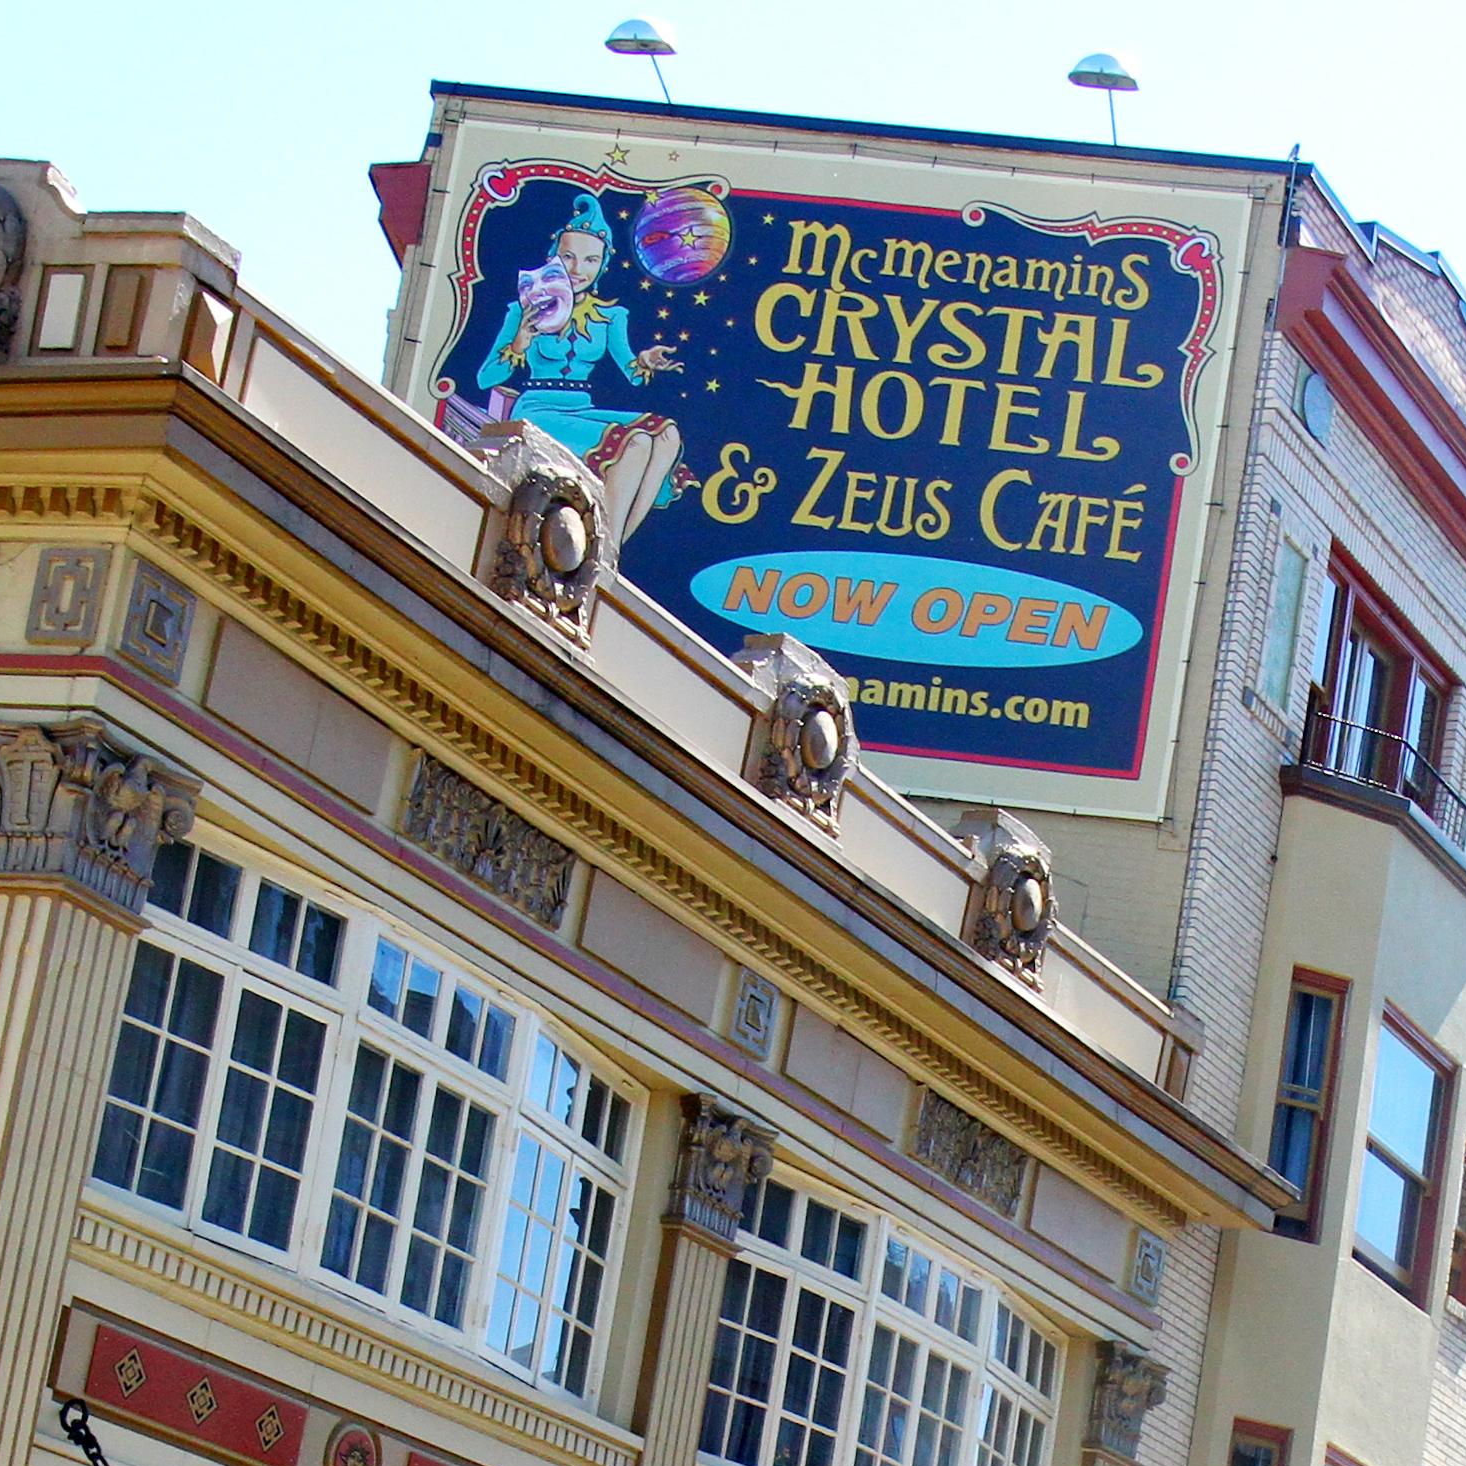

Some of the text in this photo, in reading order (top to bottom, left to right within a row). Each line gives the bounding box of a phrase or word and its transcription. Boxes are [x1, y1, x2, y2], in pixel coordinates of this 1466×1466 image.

[753, 283, 1165, 390] CRYSTAL
[755, 364, 1122, 463] HOTEL
[702, 442, 1148, 565] & ZEUS CAFÉ
[723, 565, 1110, 651] NOW OPEN
